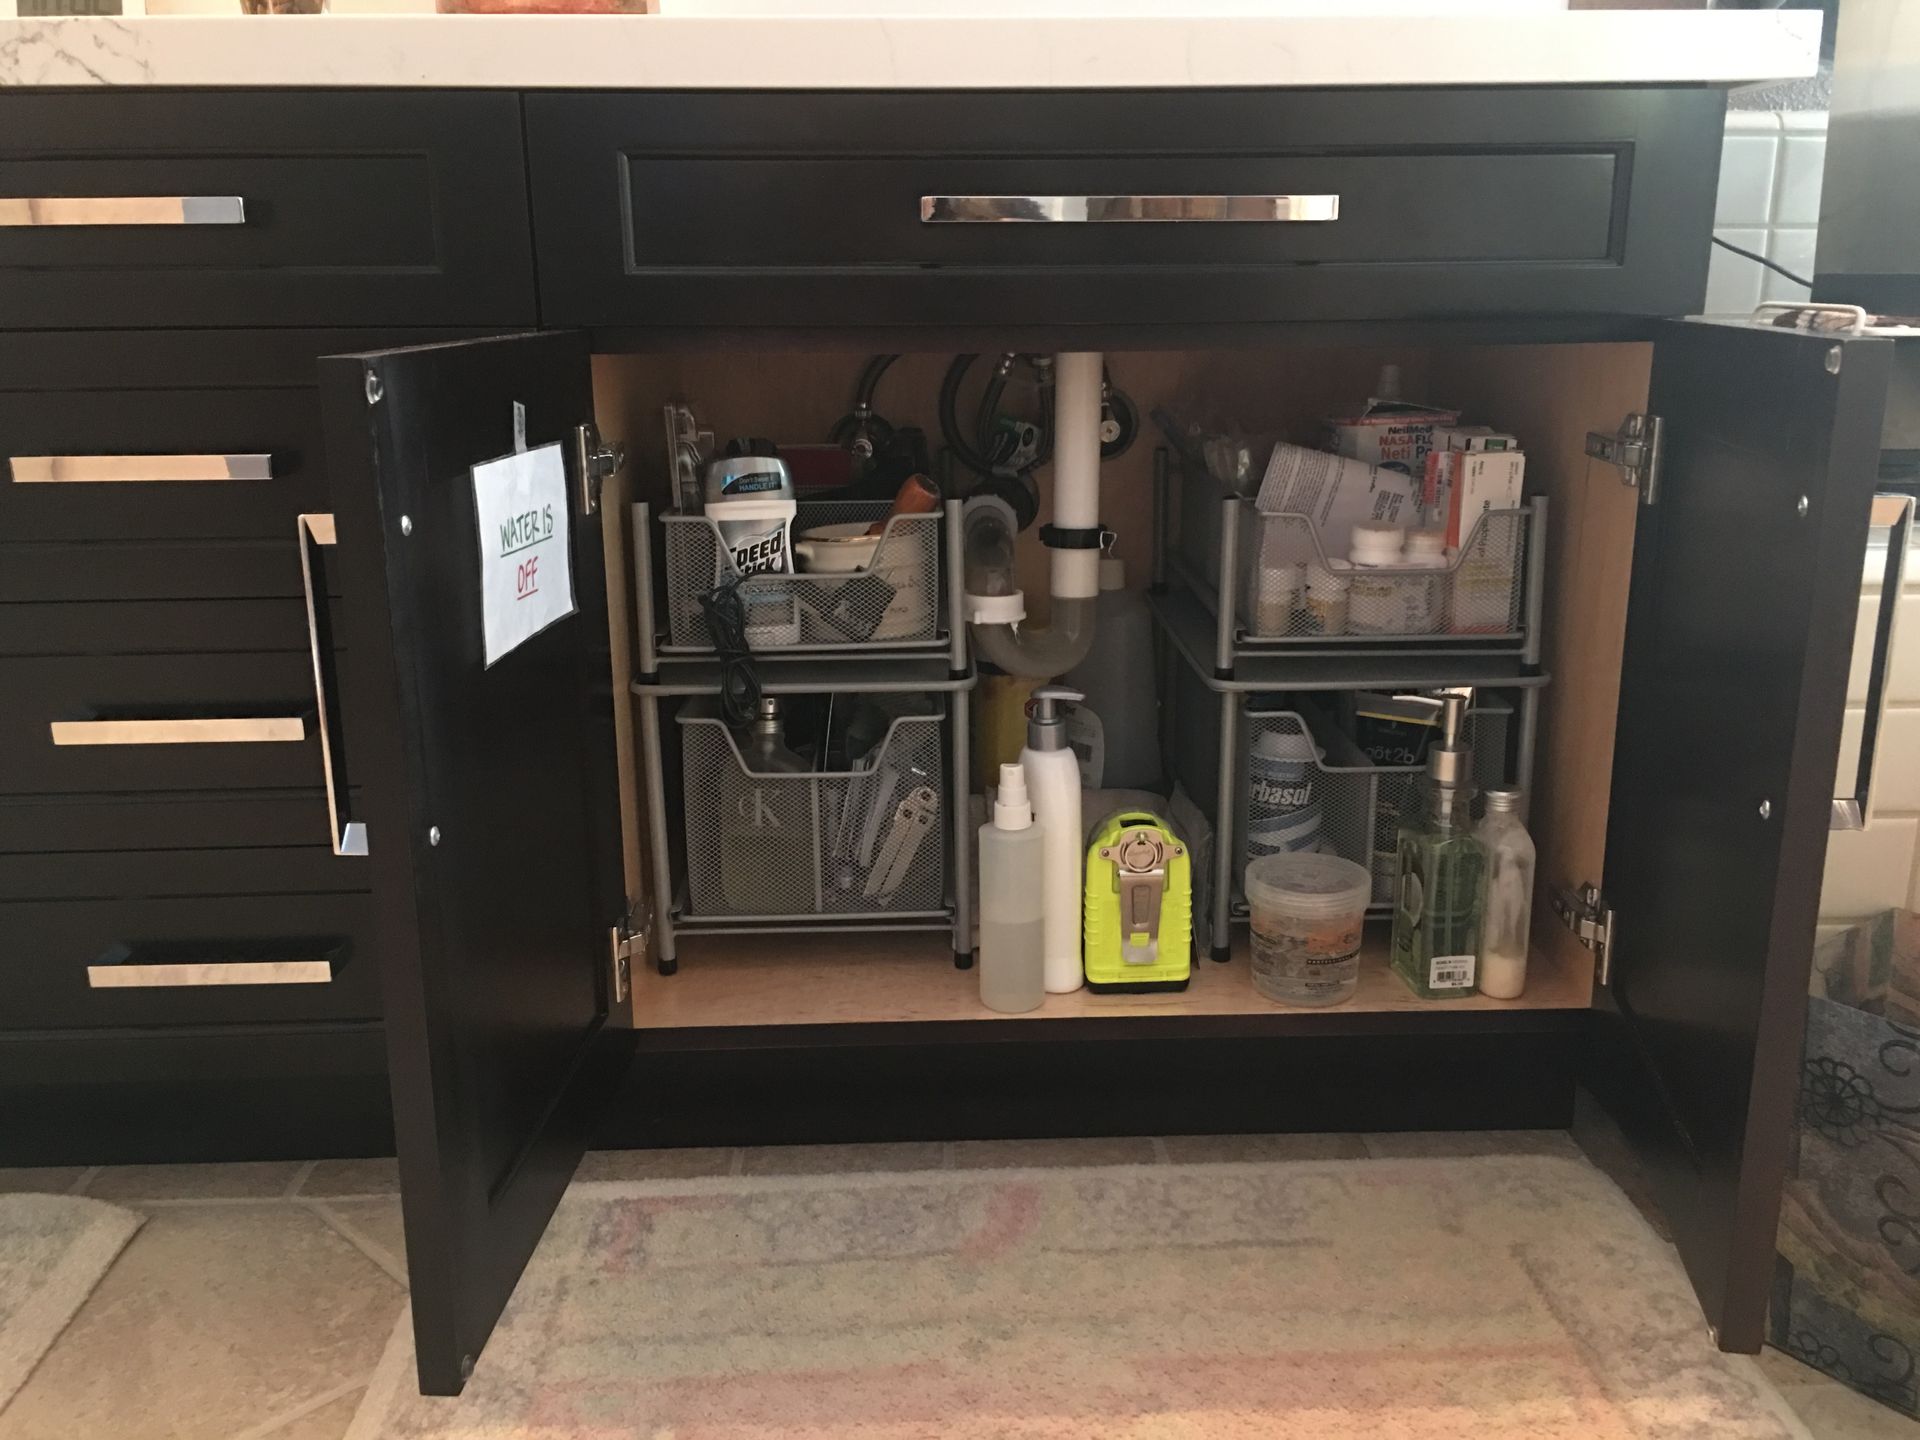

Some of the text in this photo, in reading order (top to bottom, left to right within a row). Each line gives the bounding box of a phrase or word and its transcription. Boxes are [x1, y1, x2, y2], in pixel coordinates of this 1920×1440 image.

[1388, 425, 1432, 435] NeilMed
[1381, 447, 1410, 460] Neti
[500, 504, 553, 552] WATER IS
[518, 556, 538, 594] OFF
